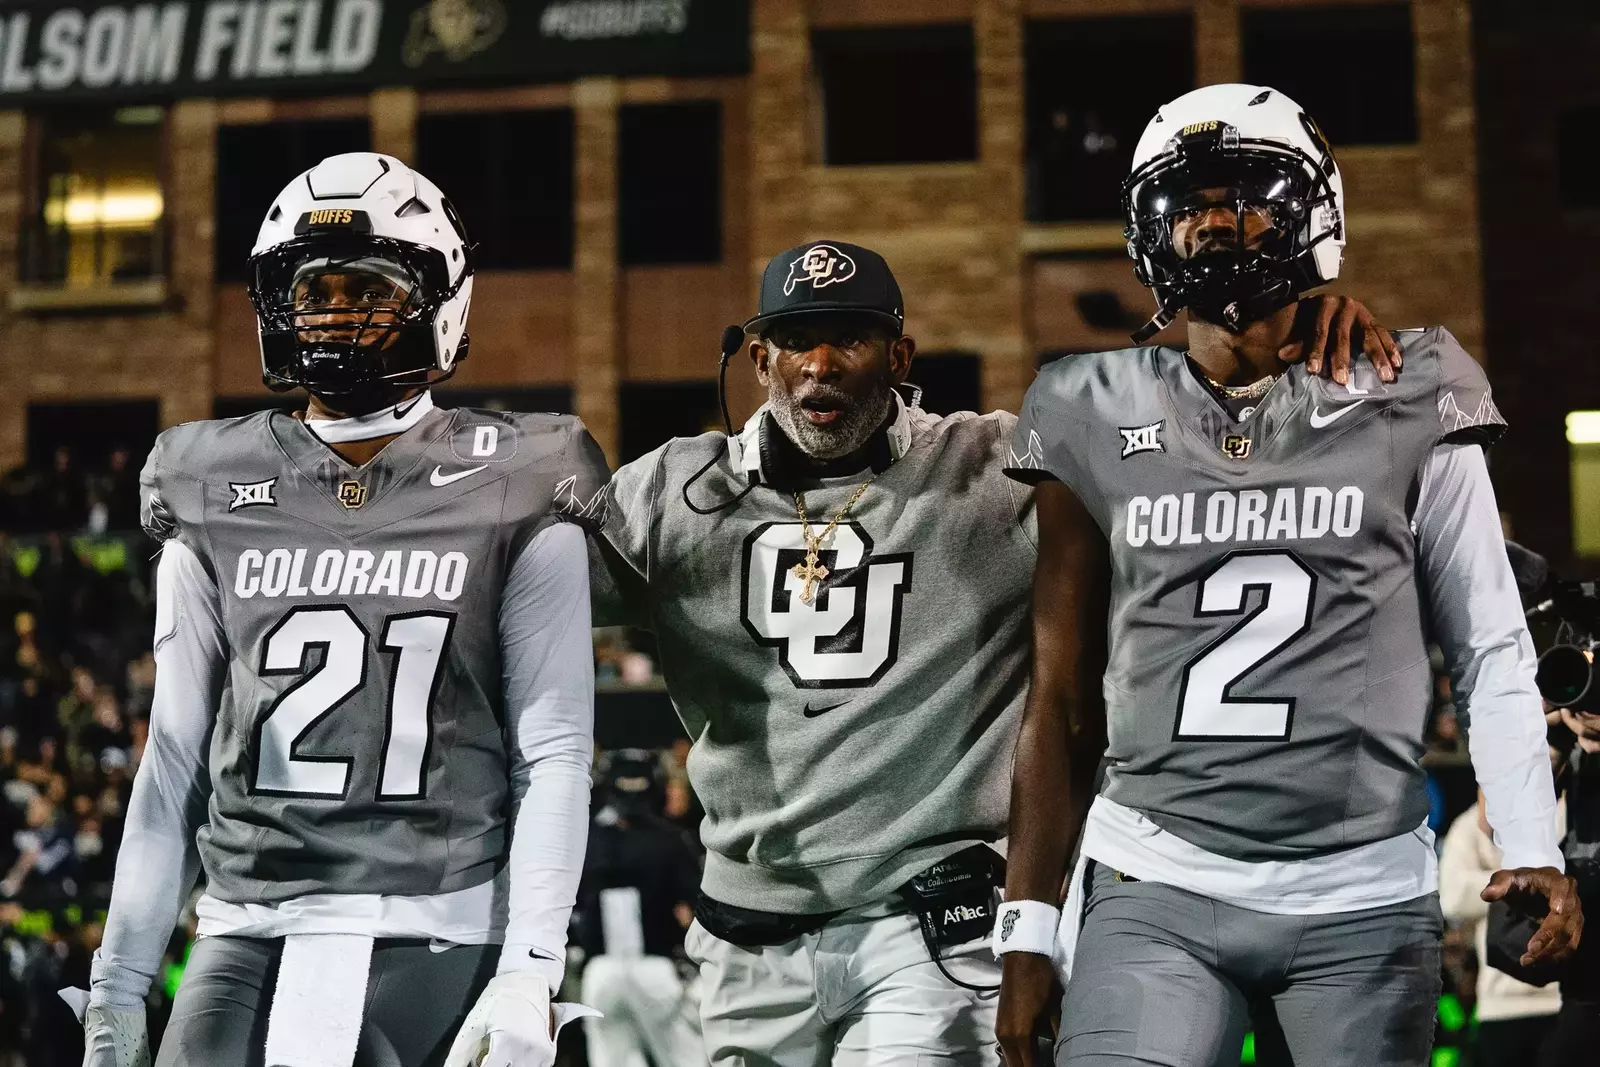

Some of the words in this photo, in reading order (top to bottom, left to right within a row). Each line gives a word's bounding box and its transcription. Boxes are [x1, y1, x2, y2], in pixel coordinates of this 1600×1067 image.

[0, 3, 189, 92] LSOM
[194, 0, 383, 81] FIELD
[1183, 120, 1217, 136] BUFFS
[309, 209, 353, 225] BUFFS
[312, 352, 340, 360] Riddell
[472, 425, 498, 457] D
[1126, 486, 1364, 548] COLORADO
[234, 548, 469, 601] COLORADO
[740, 521, 914, 688] CU
[1172, 548, 1318, 742] 2
[248, 604, 458, 801] 21
[943, 905, 986, 926] Aflac
